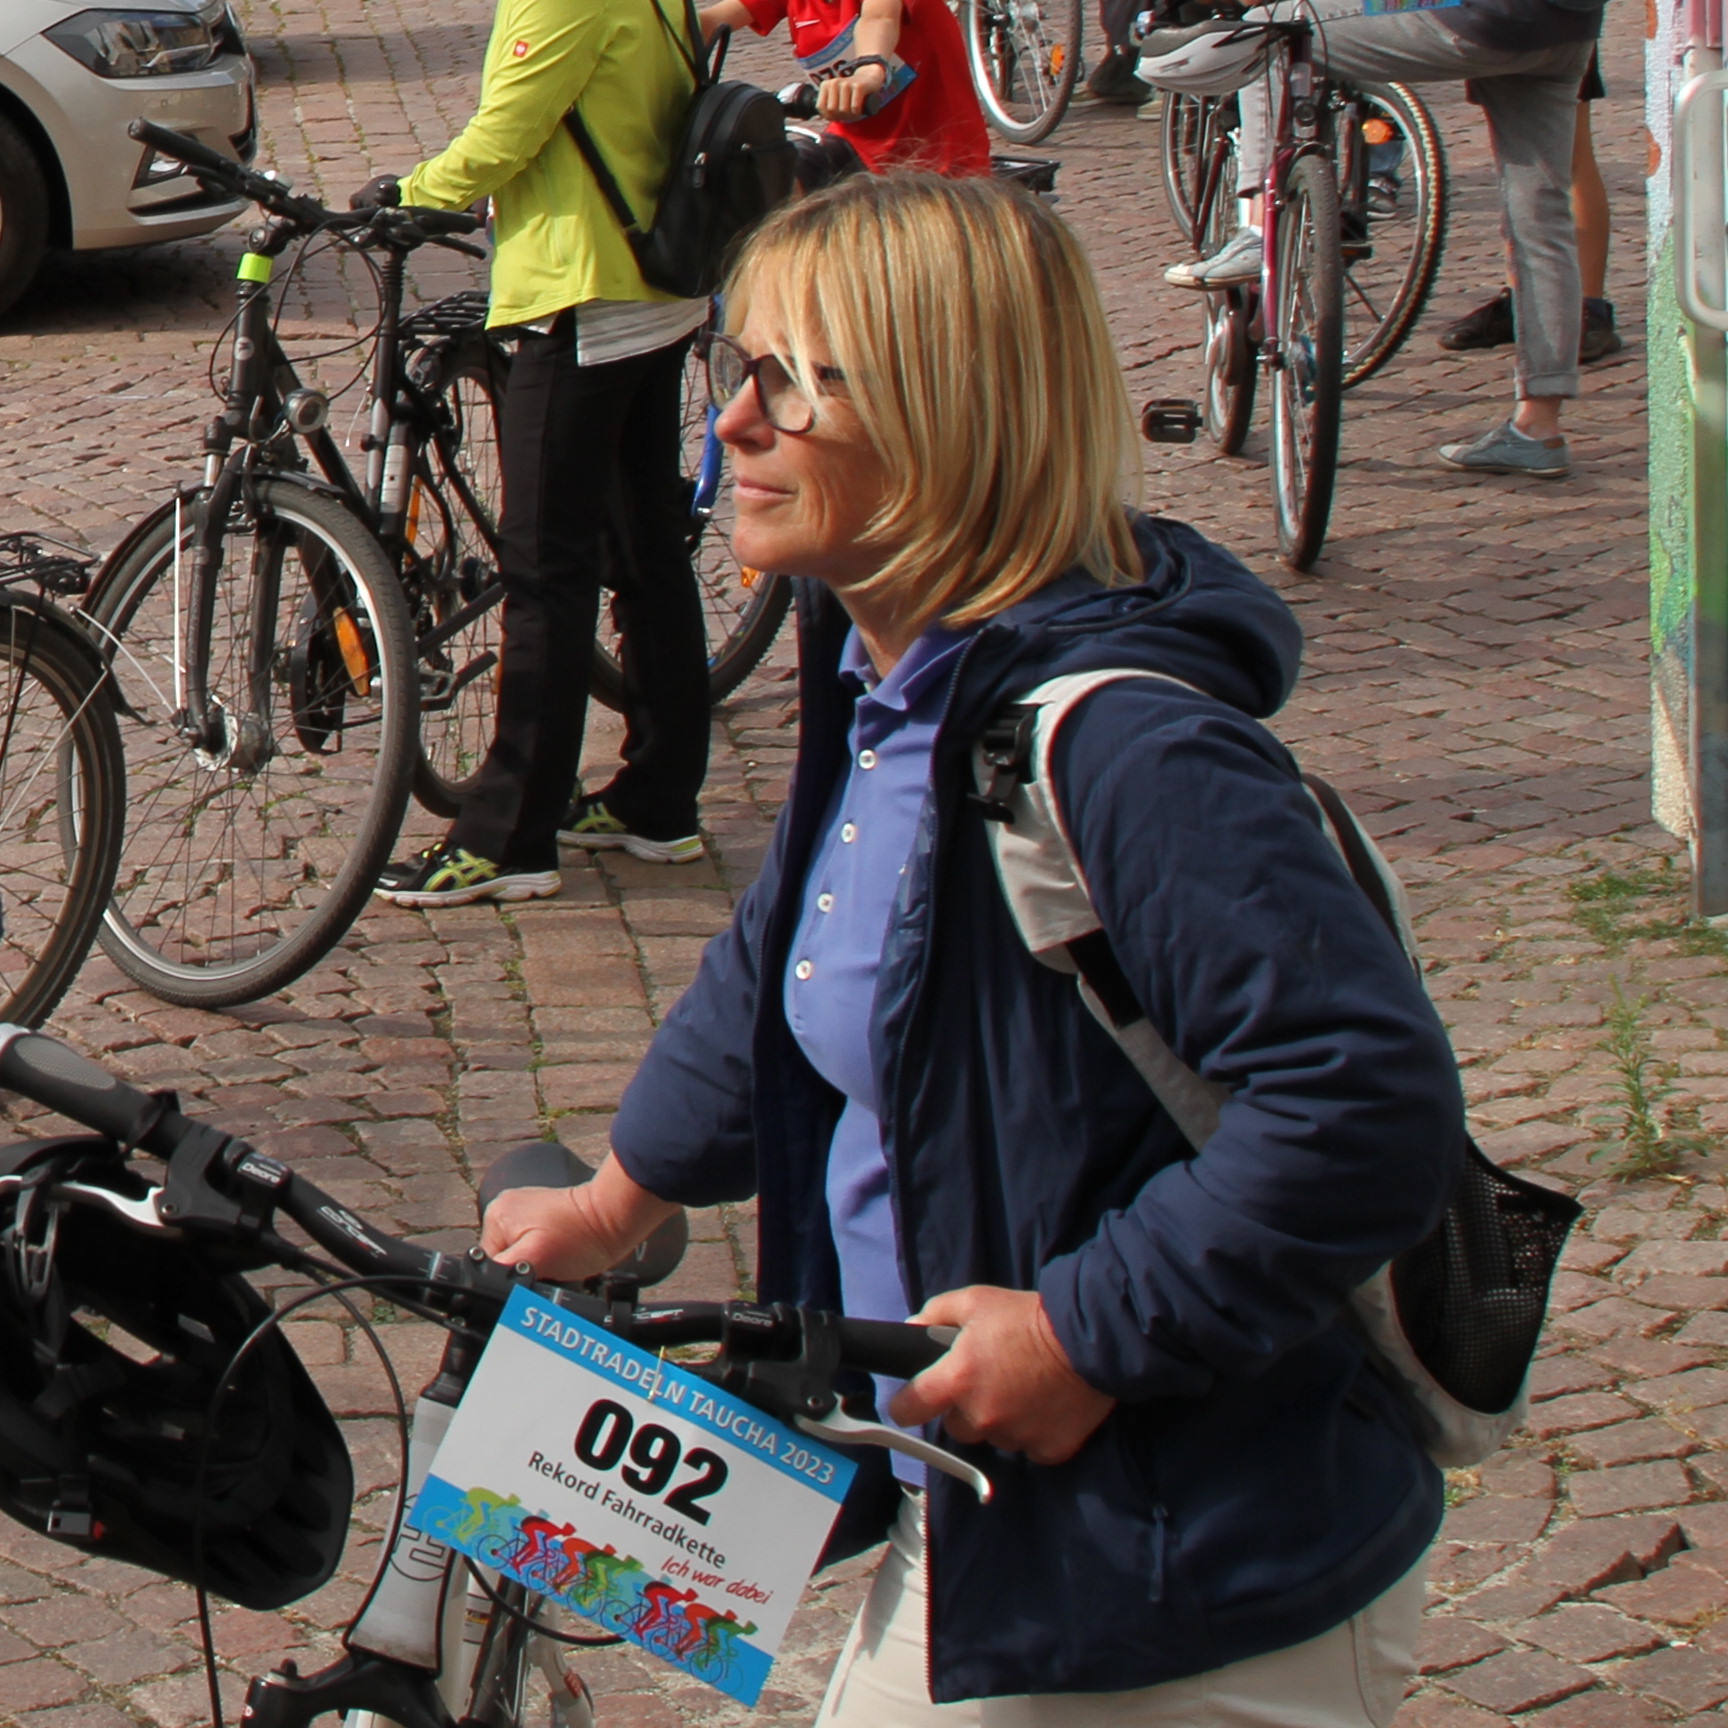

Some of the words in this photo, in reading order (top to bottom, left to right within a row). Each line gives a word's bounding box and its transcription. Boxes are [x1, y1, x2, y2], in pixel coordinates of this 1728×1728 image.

[520, 1306, 689, 1406] STADTRADELN
[690, 1389, 777, 1456] TAUCHA
[779, 1440, 837, 1485] 2023
[527, 1450, 601, 1502] Rekord
[600, 1487, 727, 1570] Fahrradkette
[574, 1397, 730, 1527] 092
[660, 1555, 690, 1575] Ich
[692, 1567, 724, 1589] war
[725, 1579, 774, 1606] dabei
